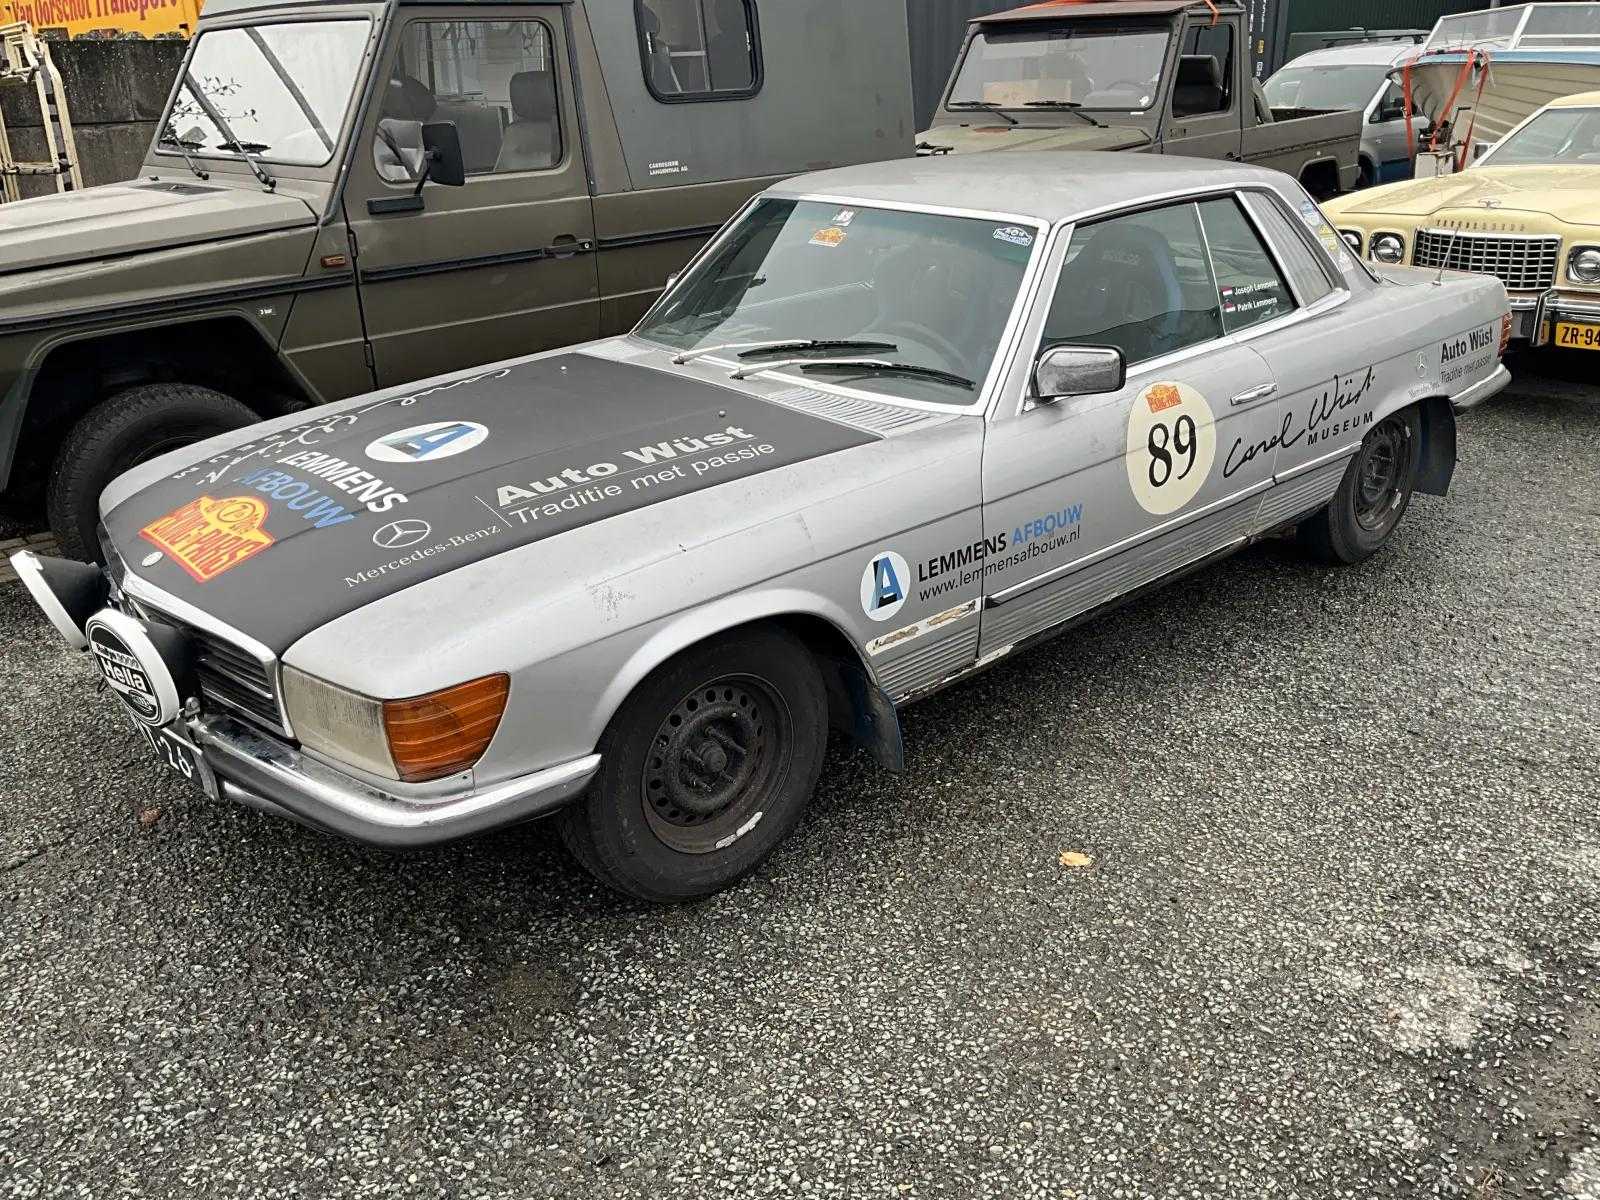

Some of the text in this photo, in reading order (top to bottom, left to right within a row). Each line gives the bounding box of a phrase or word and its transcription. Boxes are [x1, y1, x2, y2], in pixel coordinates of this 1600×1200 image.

[12, 1, 34, 27] Van
[1441, 325, 1493, 363] Auto Wüst
[1147, 414, 1197, 488] 89
[1307, 411, 1373, 445] MUSEUM
[276, 450, 409, 513] LEMMENS
[496, 425, 755, 507] Auto Wüst
[508, 442, 776, 524] Traditie met passie
[344, 525, 501, 588] Mercedes-Benz
[918, 503, 1083, 583] LEMMENS AFBOUW
[919, 525, 1081, 602] www.lemmensafbouw.nl
[101, 657, 147, 692] Hella
